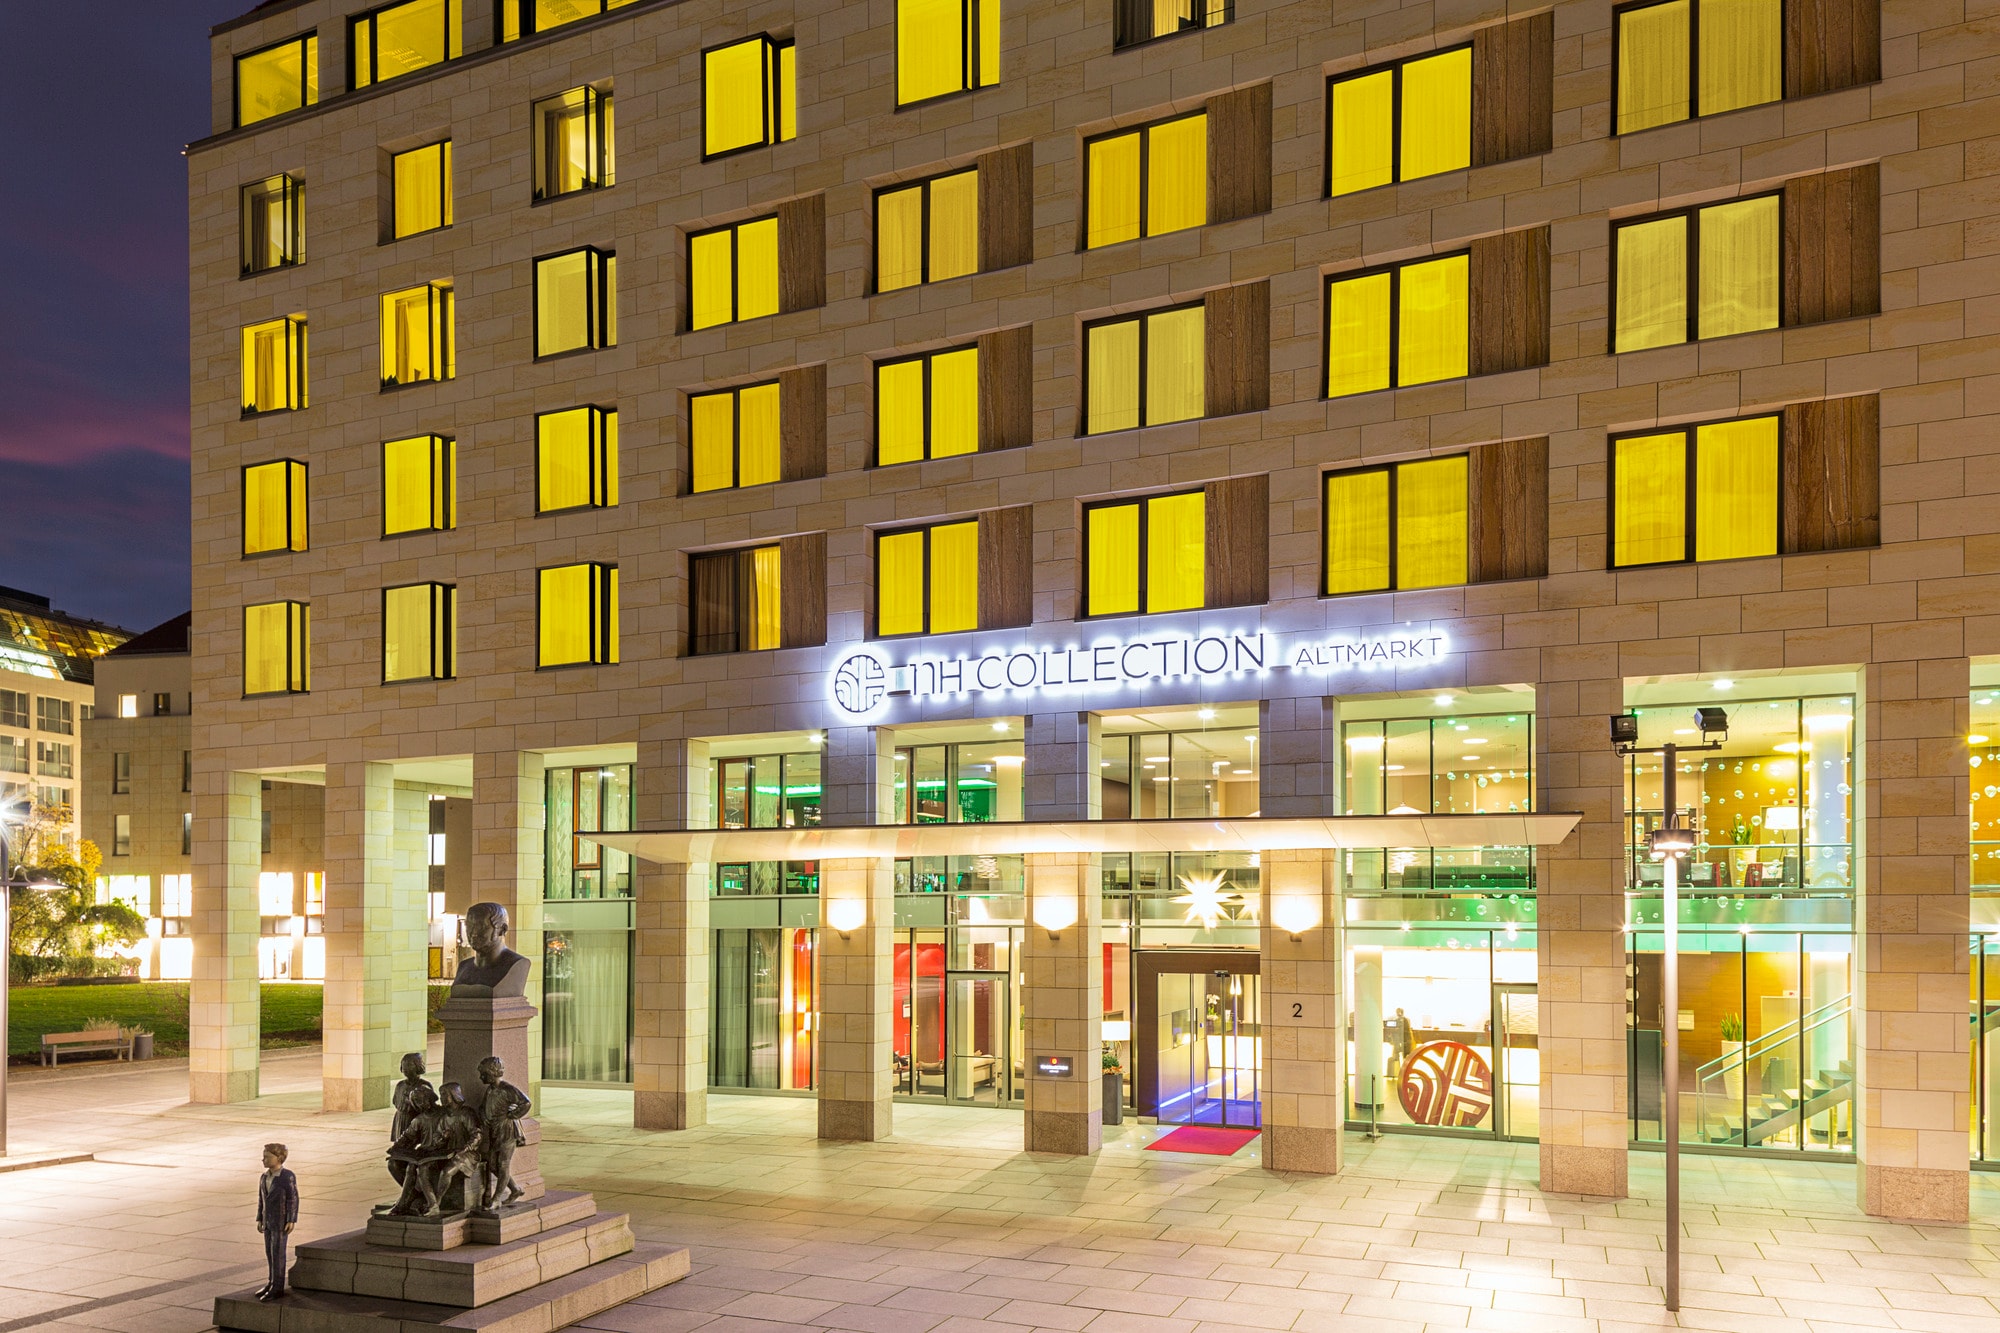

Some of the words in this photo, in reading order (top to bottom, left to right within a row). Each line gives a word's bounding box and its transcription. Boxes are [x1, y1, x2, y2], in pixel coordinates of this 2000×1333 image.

[976, 633, 1264, 690] COLLECTION
[1296, 637, 1442, 666] ALTMARKT
[1292, 1002, 1303, 1018] 2
